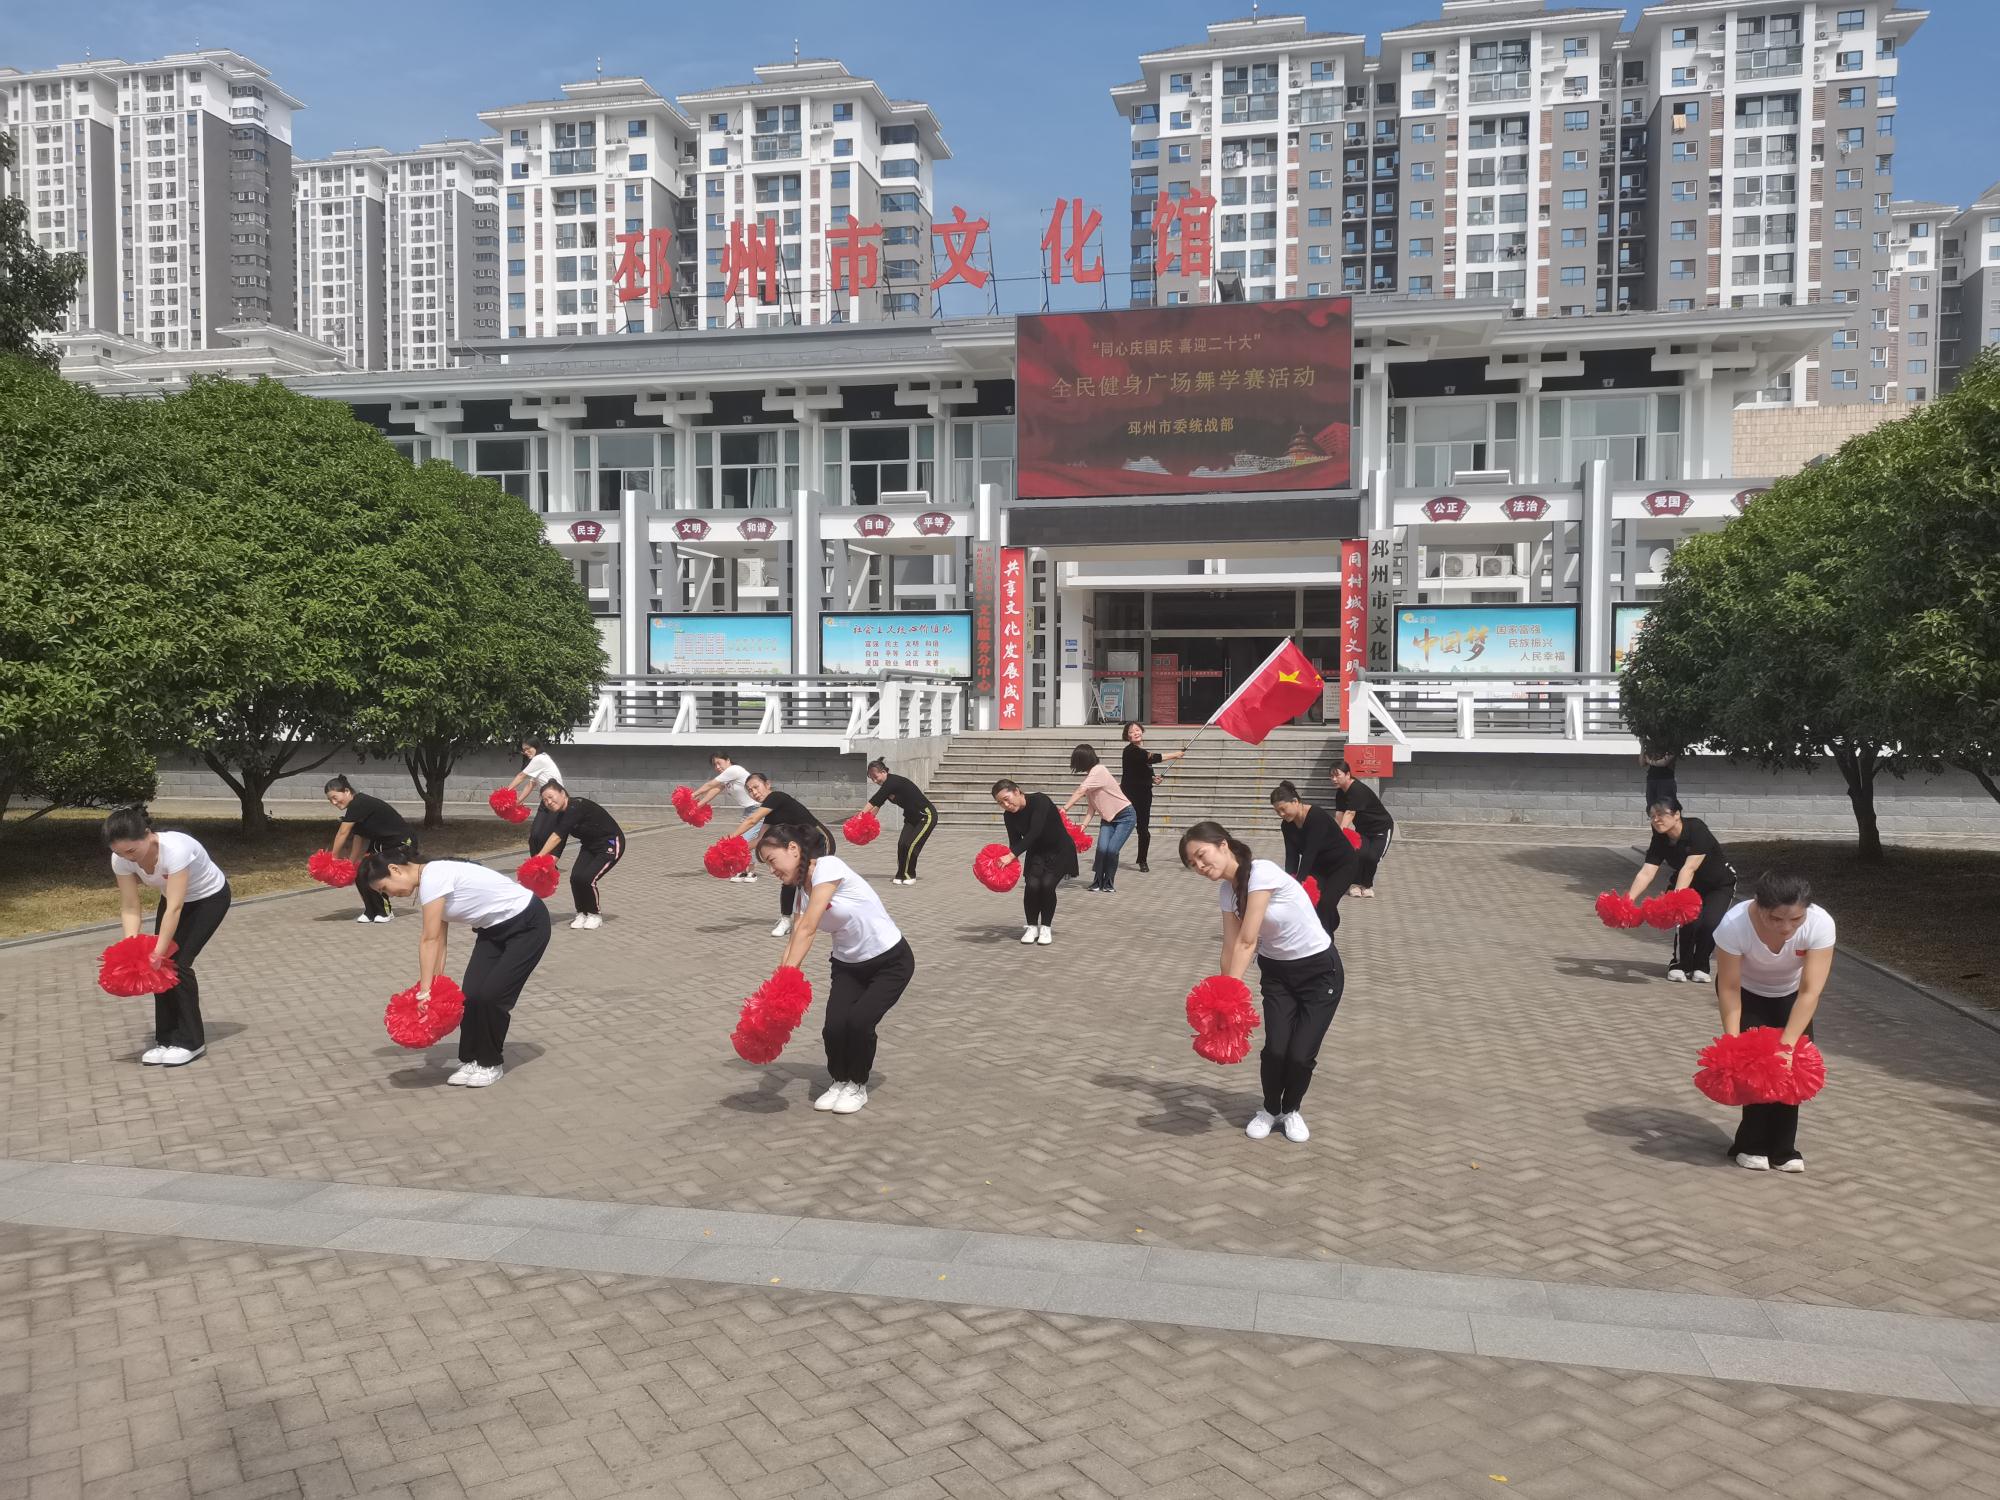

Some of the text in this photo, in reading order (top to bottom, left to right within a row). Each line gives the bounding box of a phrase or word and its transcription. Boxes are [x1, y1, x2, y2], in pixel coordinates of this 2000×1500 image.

[613, 189, 1216, 308] 邳州市文化馆
[1051, 365, 1316, 399] 全民健身广场舞学赛活动
[1127, 416, 1235, 436] 邳州市委统战部
[1513, 500, 1538, 512] 法治
[1654, 495, 1681, 508] 爱国
[1434, 502, 1459, 513] 公正
[746, 522, 767, 533] 和谐
[865, 519, 884, 530] 自由
[923, 517, 944, 528] 平等
[576, 525, 596, 536] 民主
[681, 523, 702, 534] 文明
[1344, 552, 1364, 713] 同树城市文明
[1003, 560, 1021, 719] 共享文化发展成果
[1412, 624, 1489, 663] 中国梦
[1508, 638, 1553, 648] 民族振兴
[1520, 652, 1565, 662] 人民幸福
